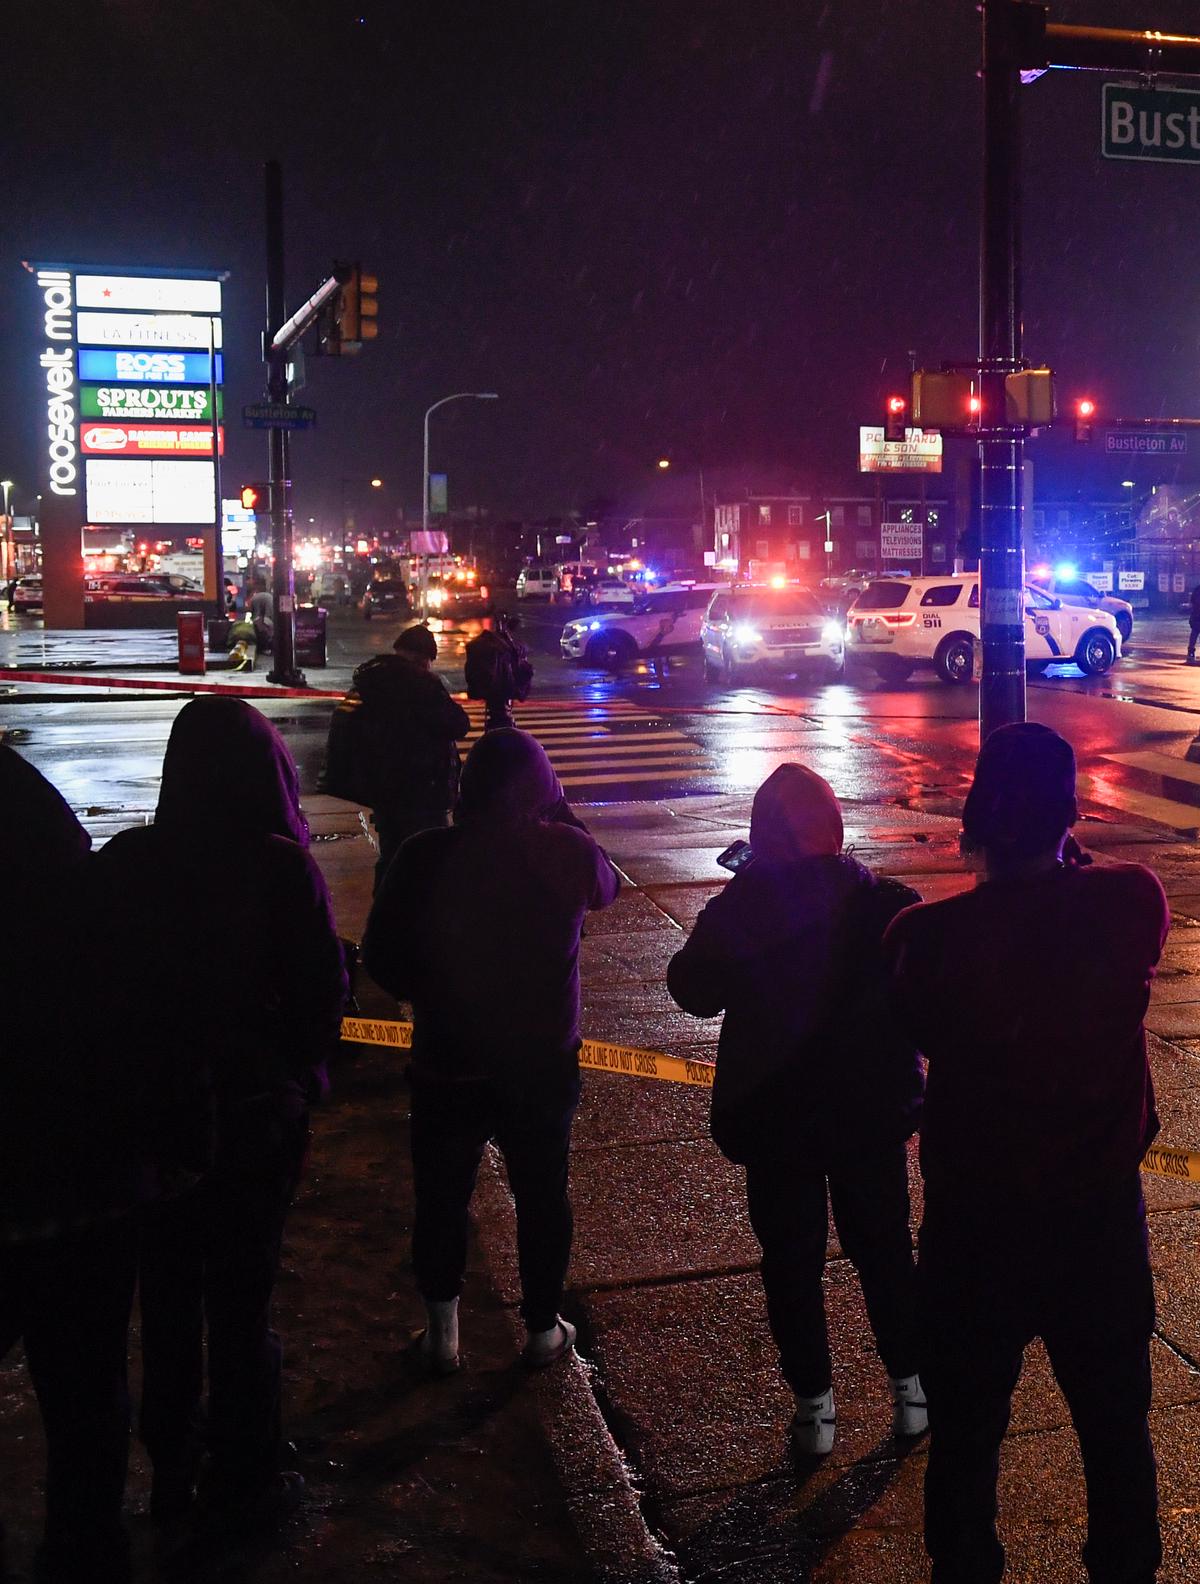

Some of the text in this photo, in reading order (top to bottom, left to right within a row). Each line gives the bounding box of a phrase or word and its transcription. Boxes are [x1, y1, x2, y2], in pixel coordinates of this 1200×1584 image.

[116, 352, 186, 372] ROSS
[37, 271, 76, 496] roosevelt mall
[97, 388, 208, 409] SPROUTS
[102, 406, 203, 419] FARMERS MARKET
[894, 443, 918, 453] SON
[1108, 436, 1185, 450] Bustleton Av
[882, 524, 922, 534] APPLIANCES
[882, 536, 922, 545] TELEVISIONS
[882, 547, 922, 557] MATTRESSES
[924, 619, 942, 628] 911
[592, 1047, 609, 1068] LINE
[609, 1049, 619, 1069] DO
[620, 1051, 633, 1072] NOT
[634, 1053, 658, 1075] CROSS
[685, 1061, 712, 1083] POLICE
[1160, 1151, 1190, 1177] CROSS
